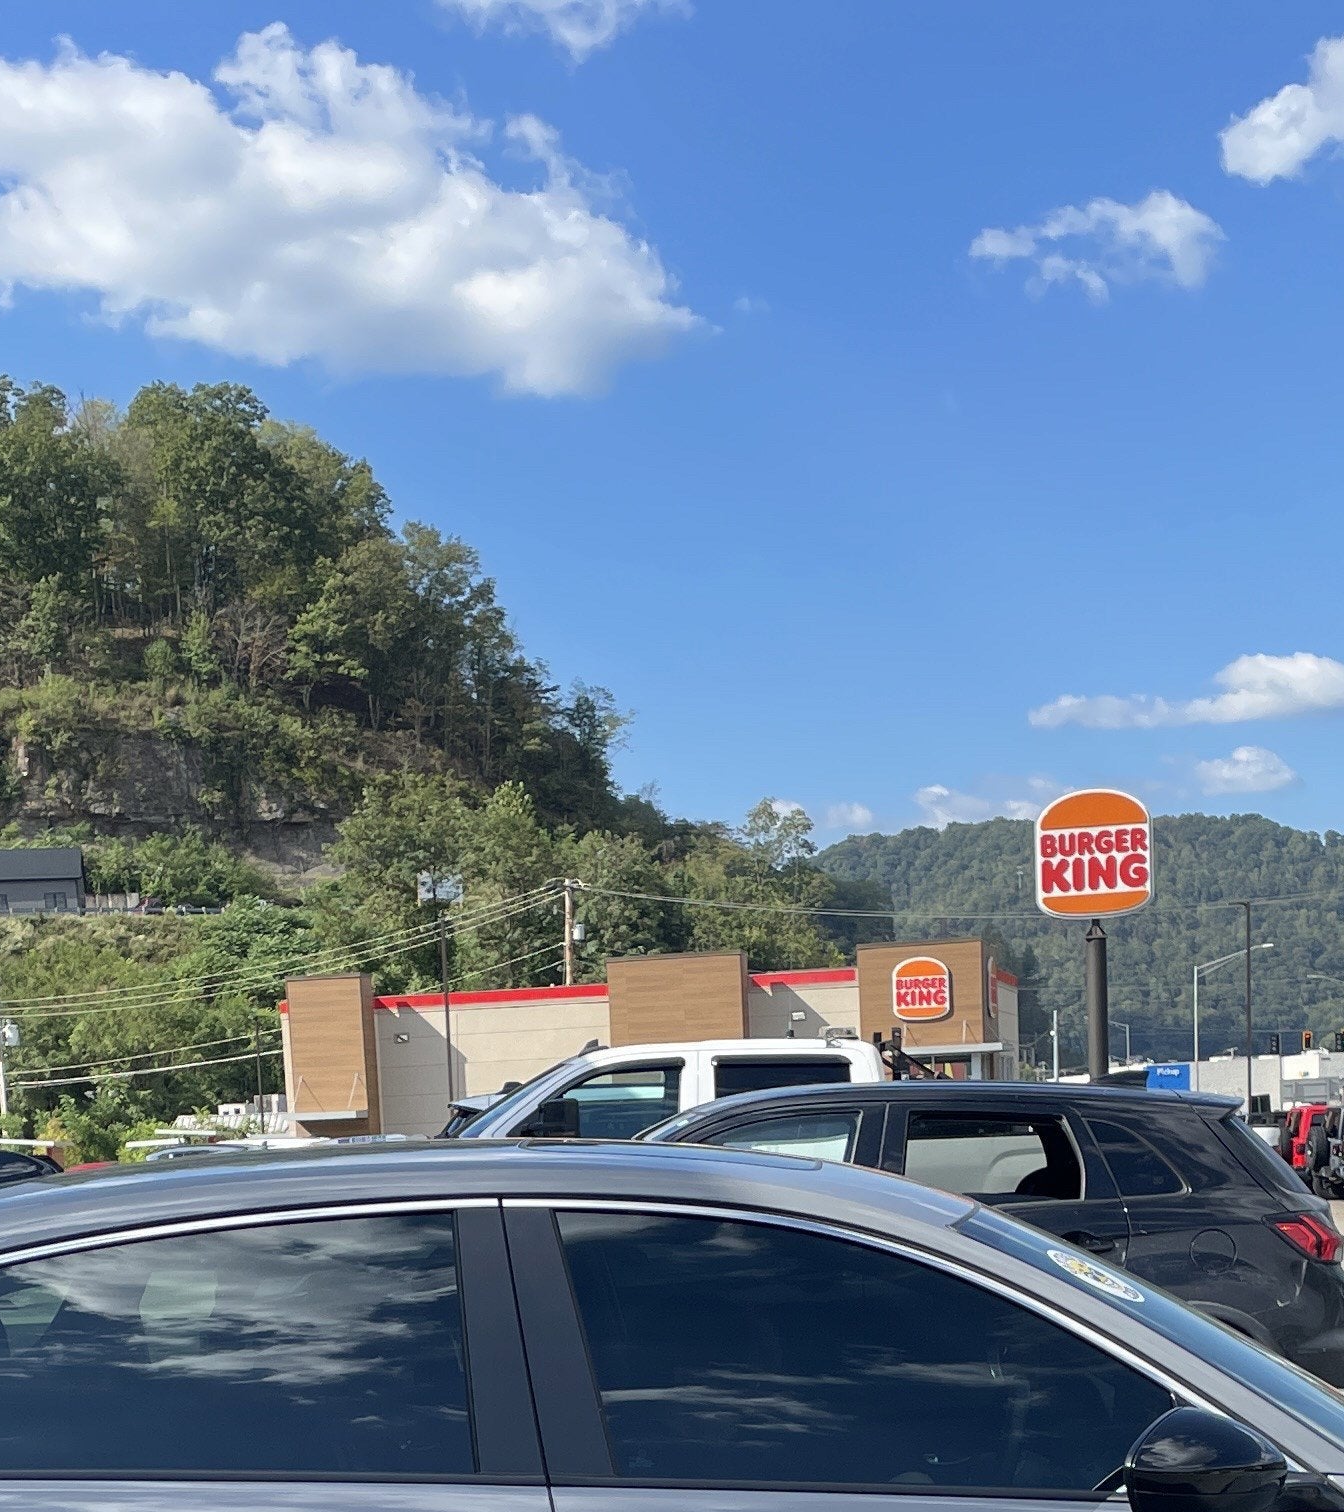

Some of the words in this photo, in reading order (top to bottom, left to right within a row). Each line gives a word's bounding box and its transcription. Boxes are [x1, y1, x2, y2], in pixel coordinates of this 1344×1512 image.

[1040, 828, 1148, 858] BURGER
[1041, 854, 1149, 893] KING
[896, 978, 946, 990] BURGER
[896, 990, 947, 1007] KING
